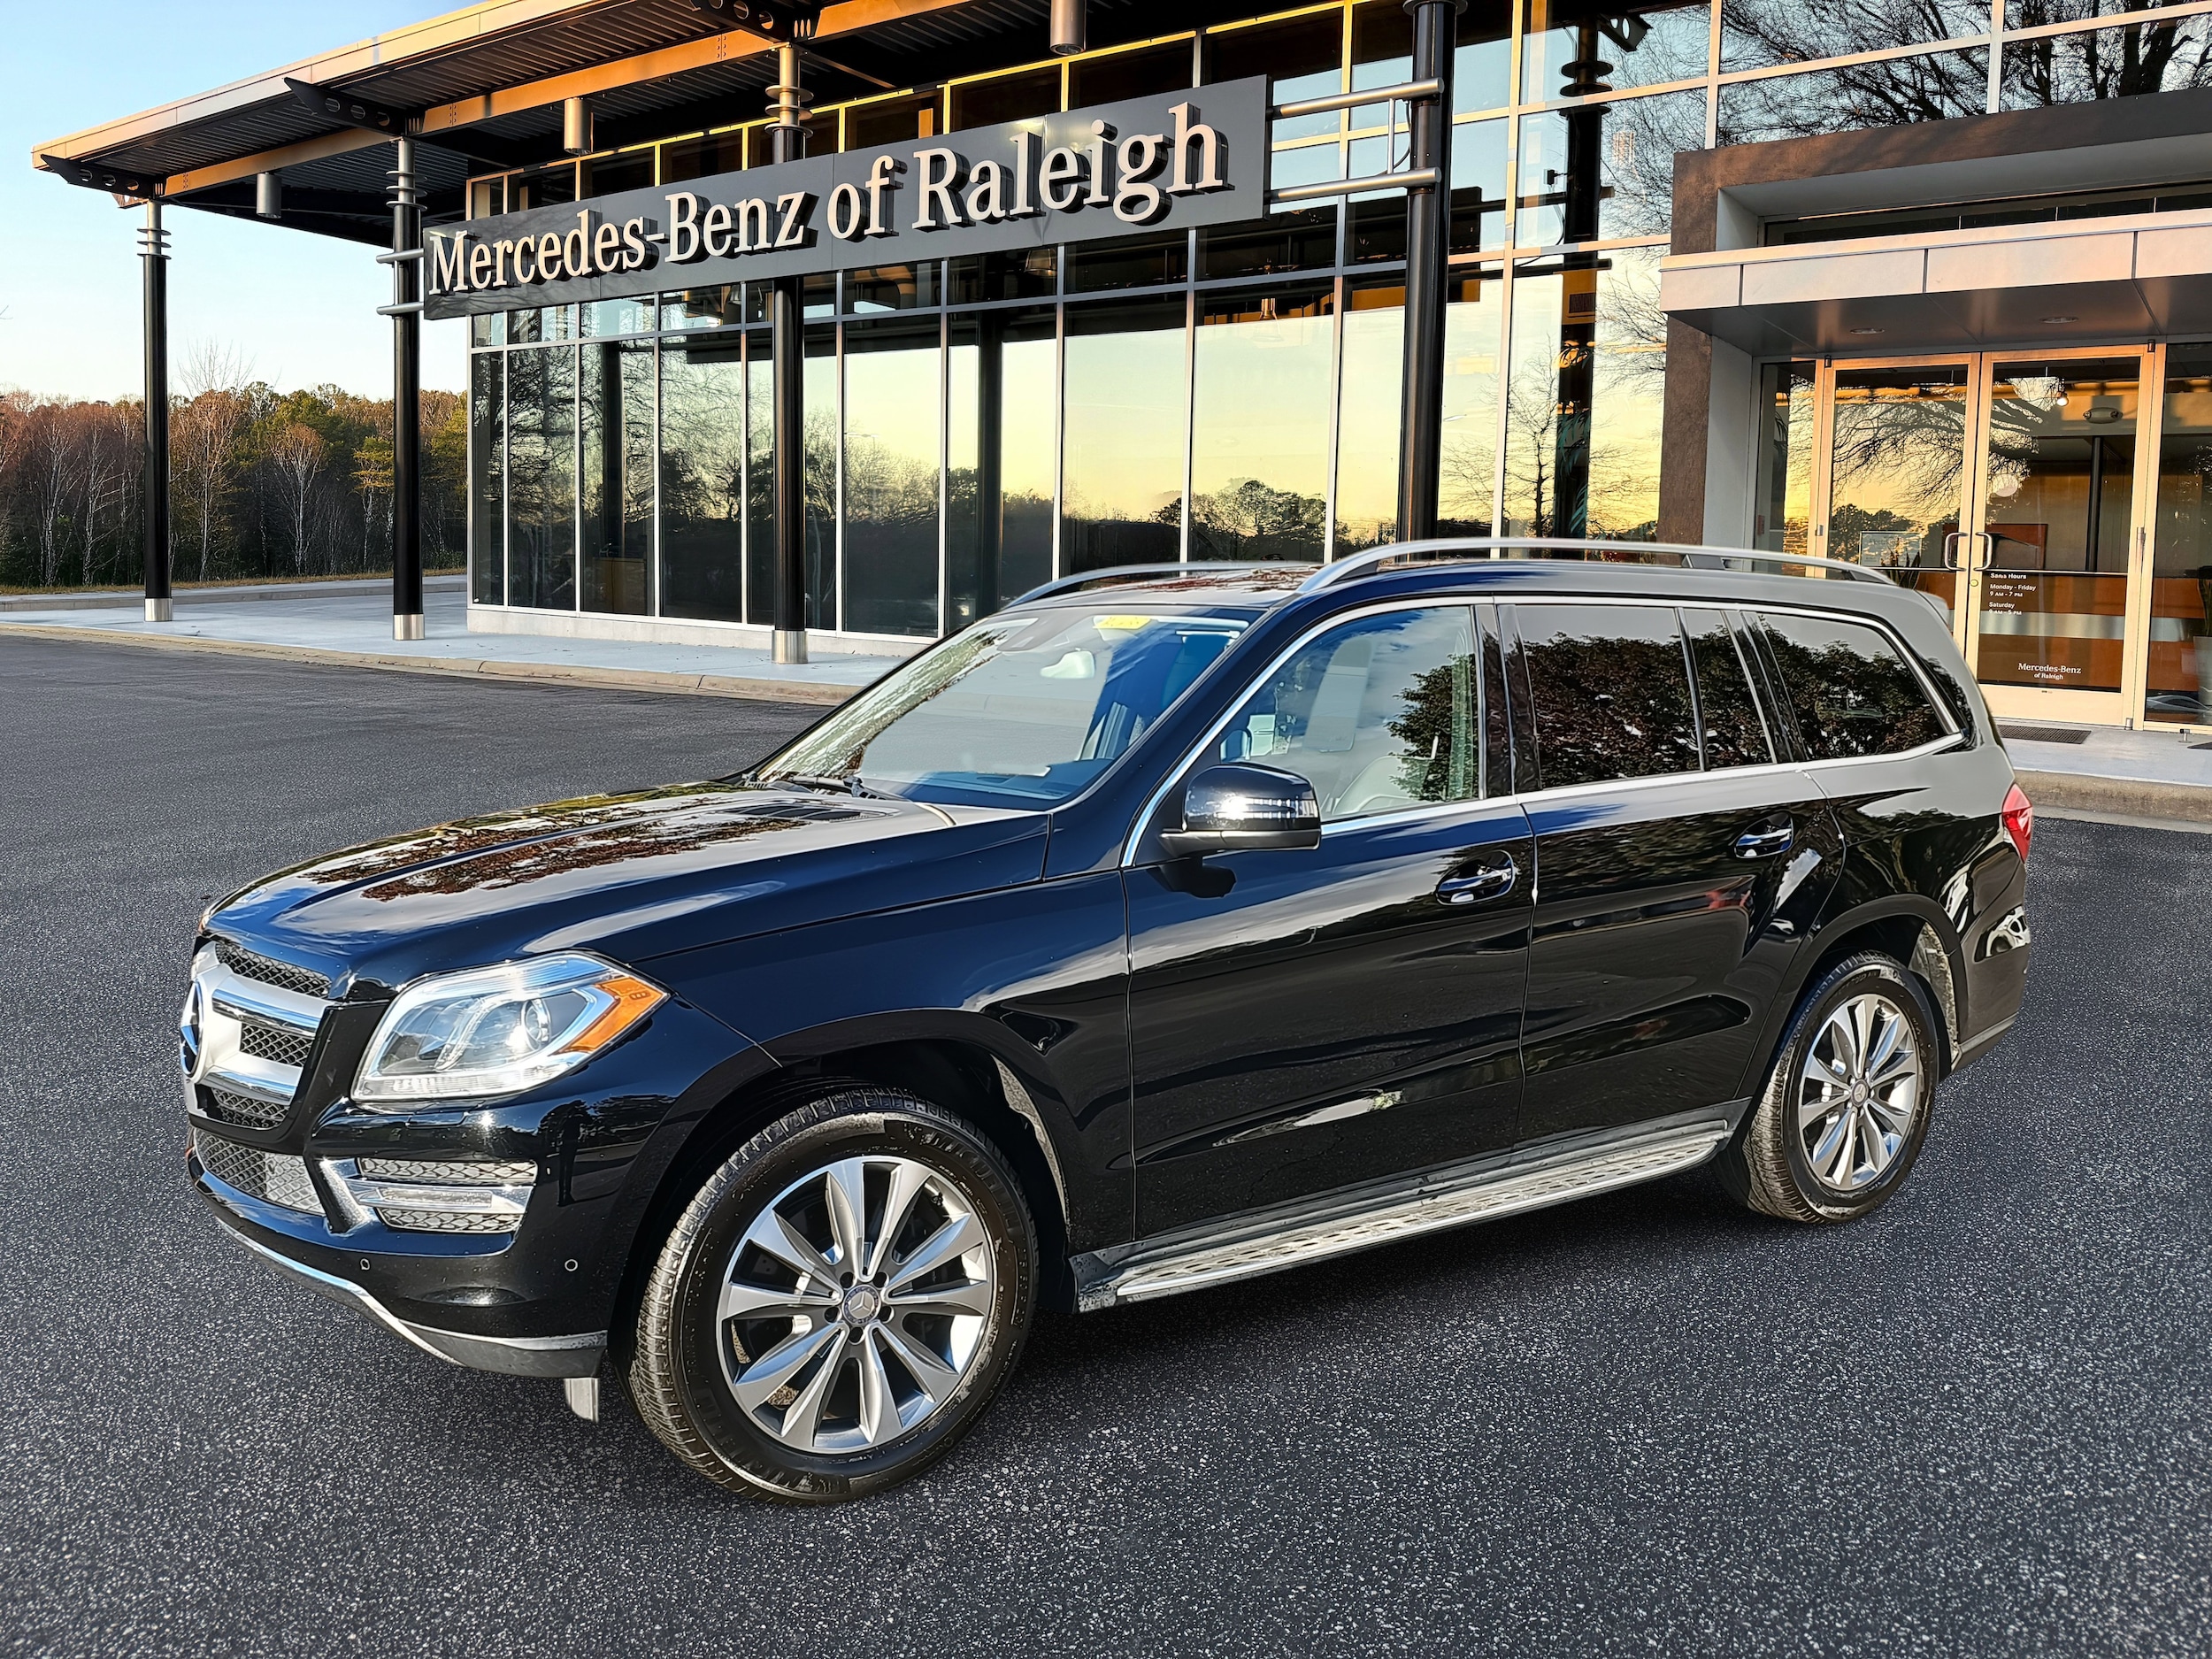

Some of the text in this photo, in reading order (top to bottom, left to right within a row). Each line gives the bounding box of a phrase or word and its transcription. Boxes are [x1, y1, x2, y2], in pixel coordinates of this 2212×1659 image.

[429, 101, 1226, 296] Mercedes-Benz of Raleigh
[2017, 663, 2082, 674] Mercedes-Benz
